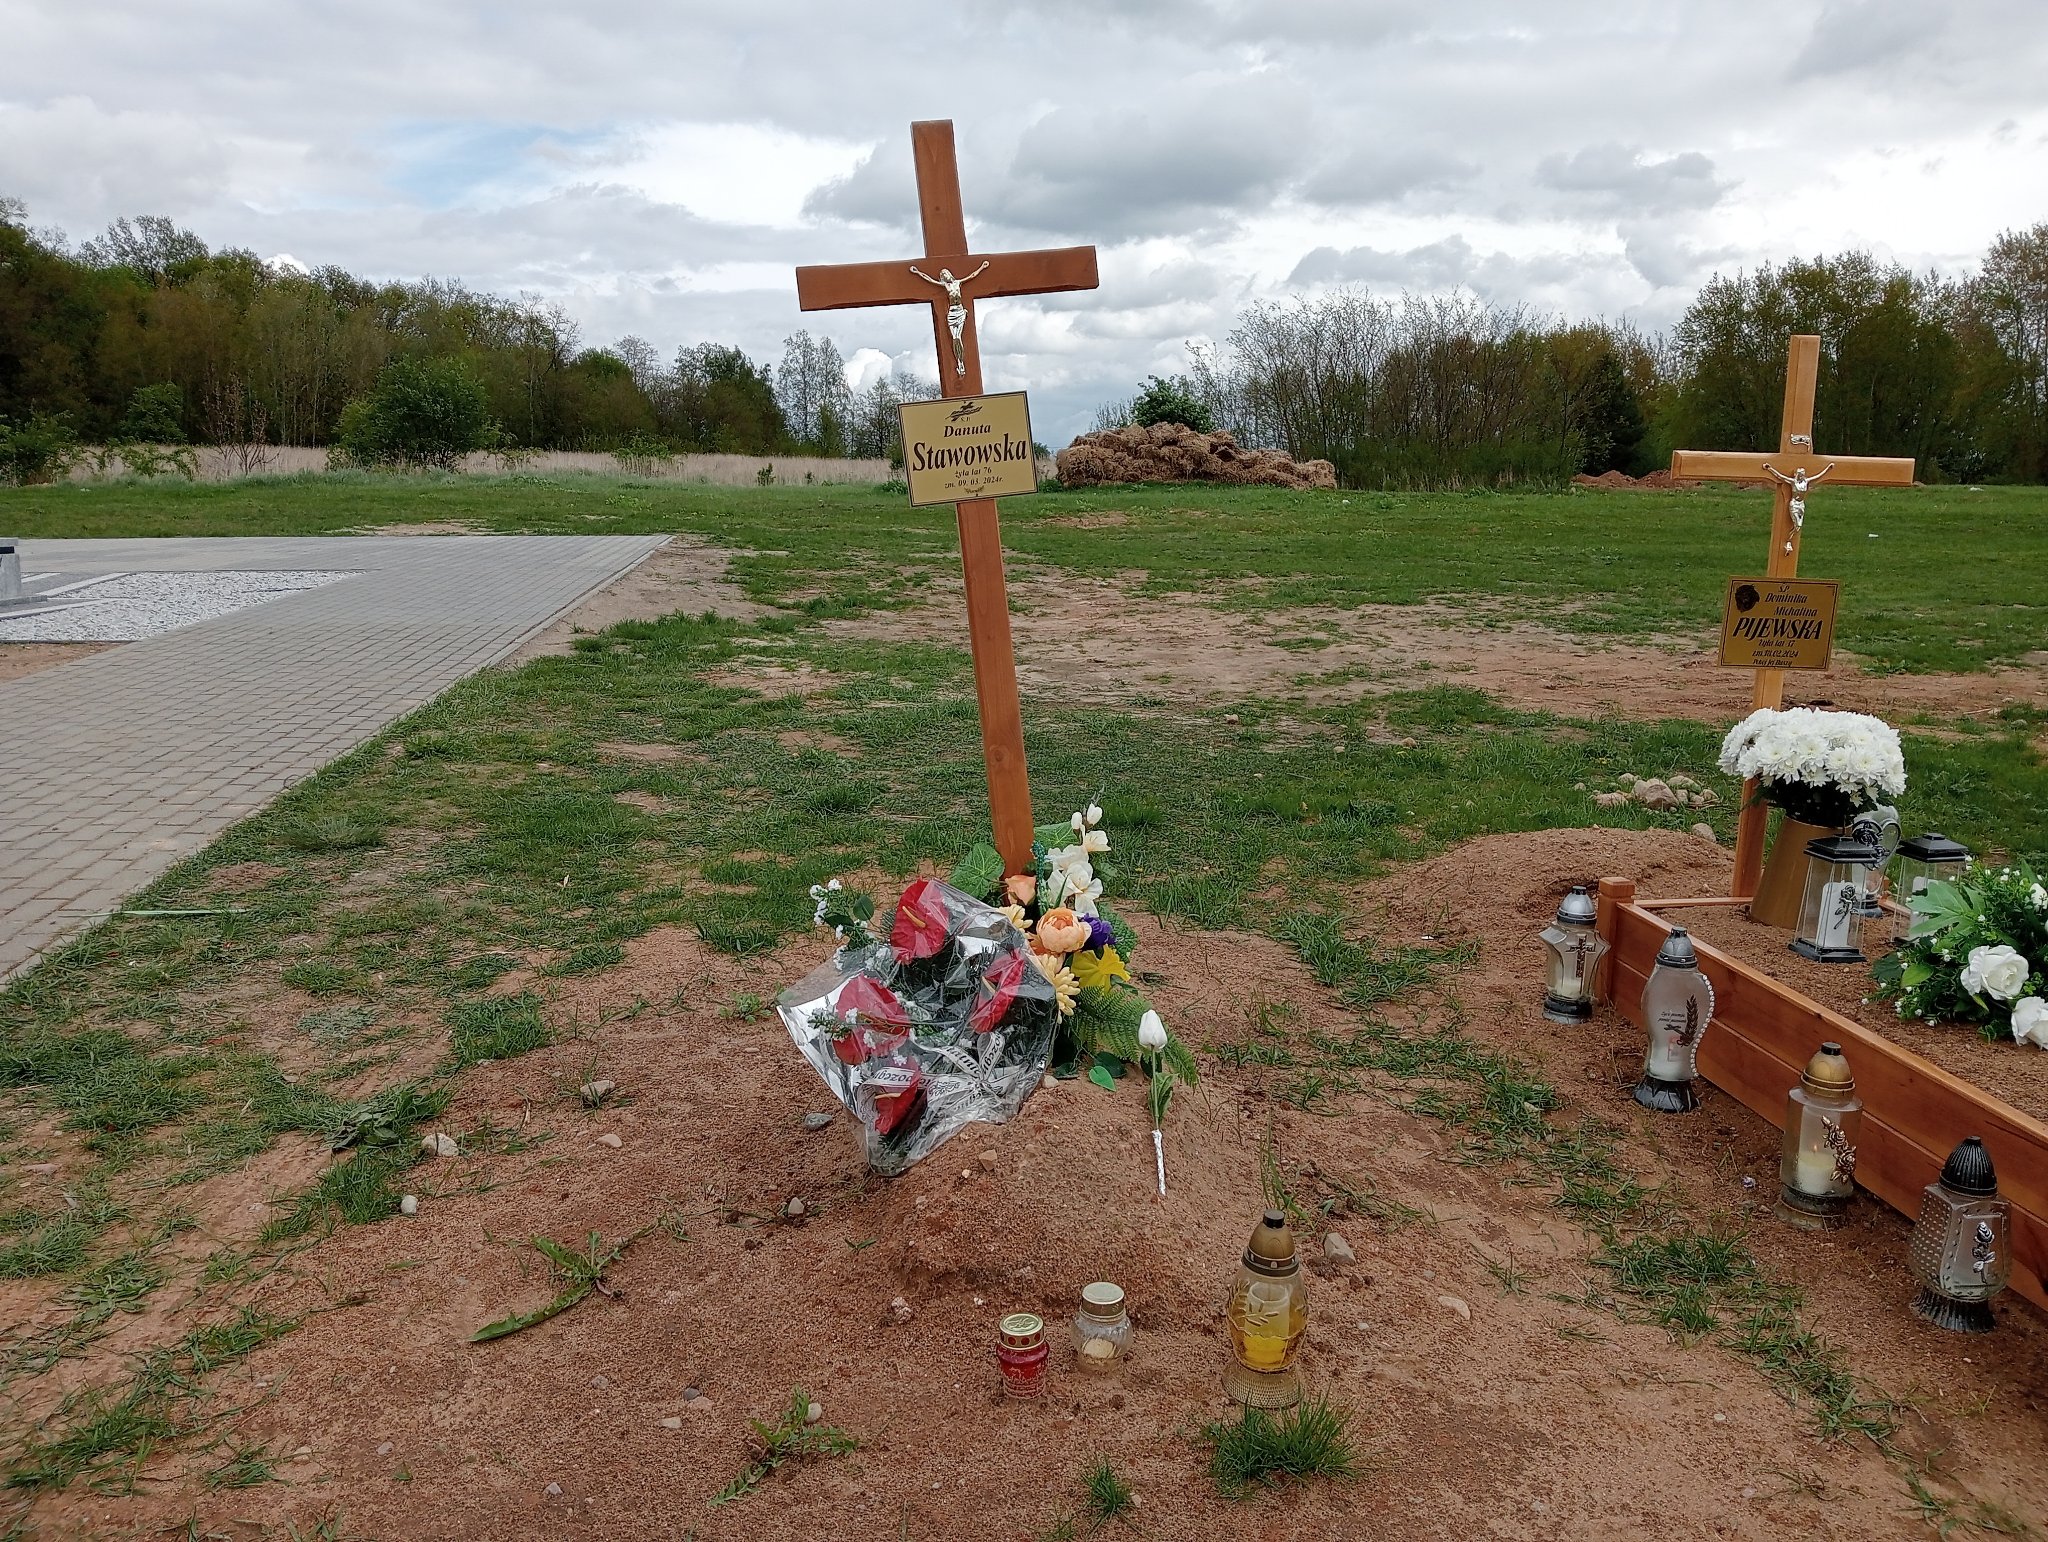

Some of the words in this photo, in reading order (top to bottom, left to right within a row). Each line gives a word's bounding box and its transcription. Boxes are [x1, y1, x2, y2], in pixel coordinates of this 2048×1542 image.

[944, 424, 991, 438] Danuta
[912, 433, 1028, 472] Stawowska
[983, 466, 992, 474] 76
[1765, 592, 1809, 604] Dominika
[1773, 606, 1818, 617] Michalina
[1732, 617, 1823, 641] PIJEWSKA
